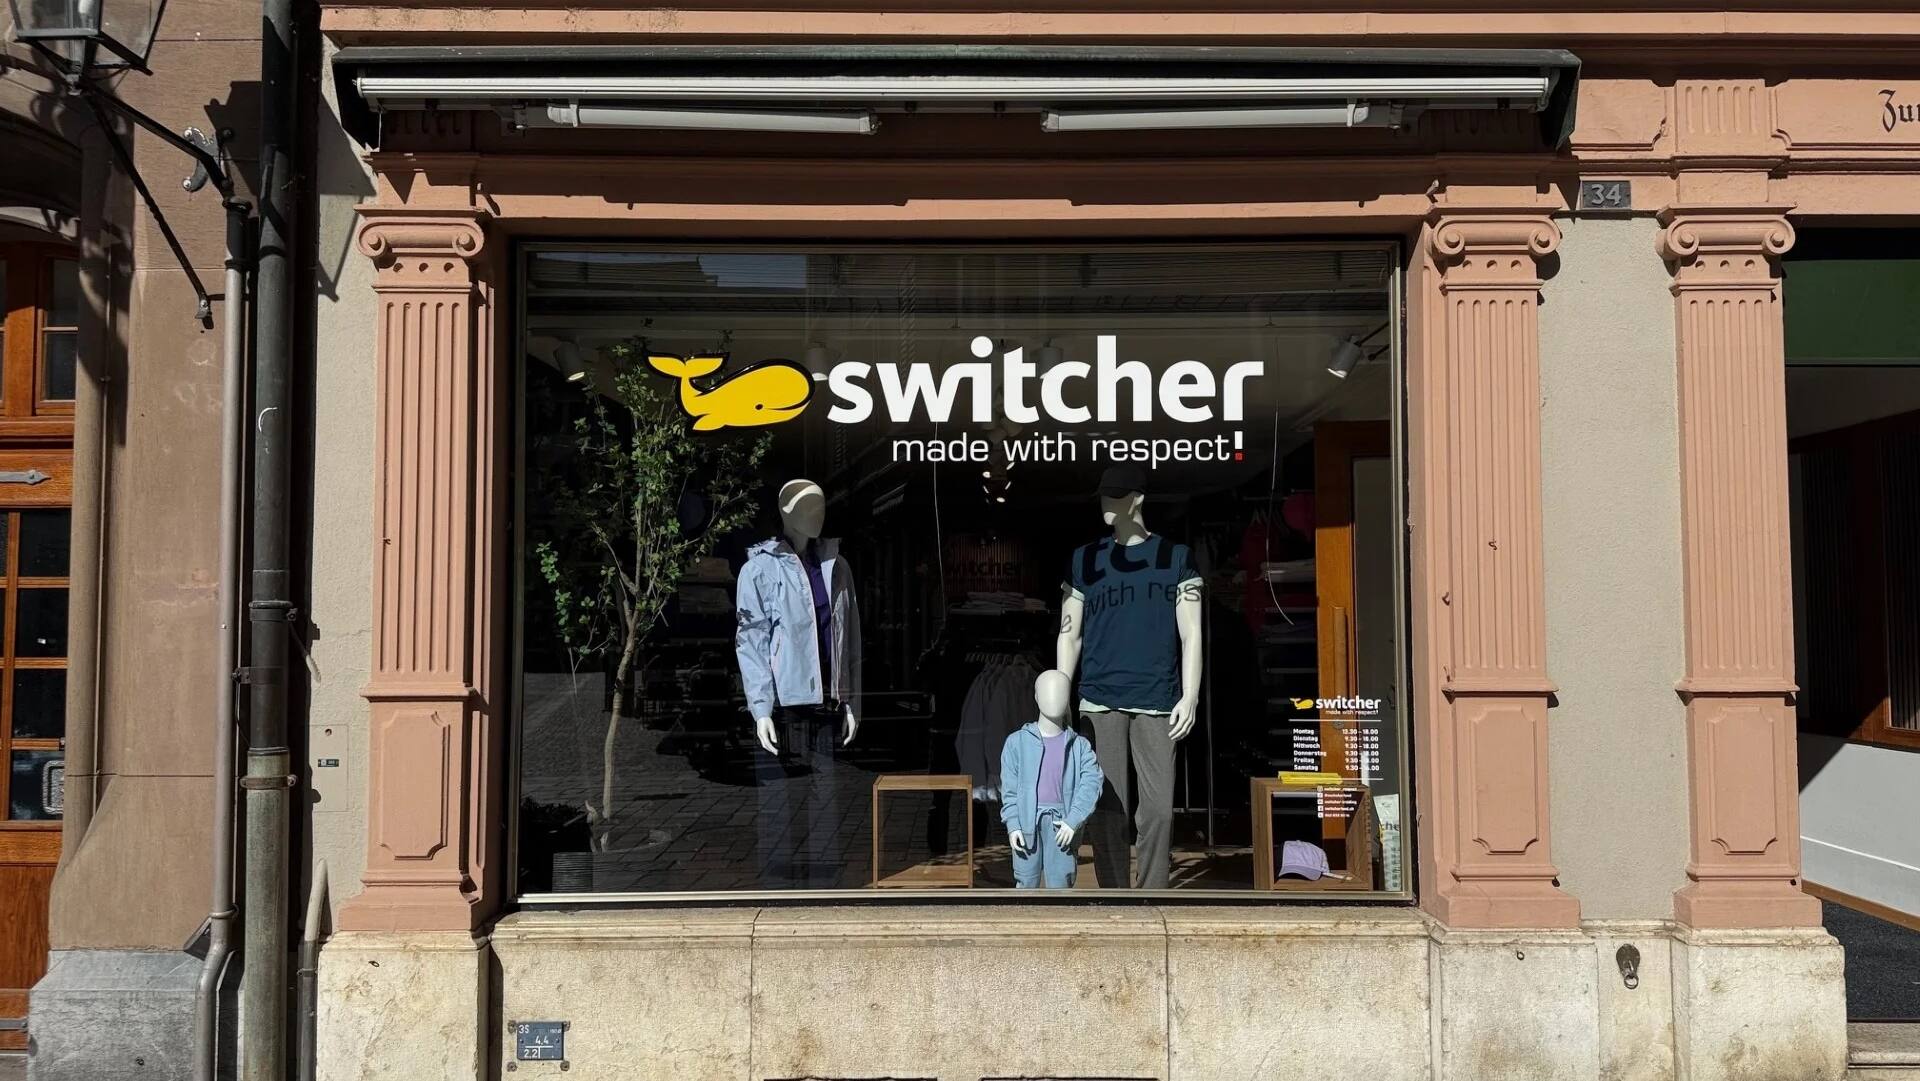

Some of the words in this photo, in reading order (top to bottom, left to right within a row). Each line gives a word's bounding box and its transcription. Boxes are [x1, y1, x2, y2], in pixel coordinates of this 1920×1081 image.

[1591, 183, 1621, 206] 34
[827, 335, 1264, 424] switcher
[892, 433, 989, 463] made
[1002, 432, 1076, 463] with
[1091, 431, 1243, 469] respect!
[1315, 695, 1381, 709] switcher
